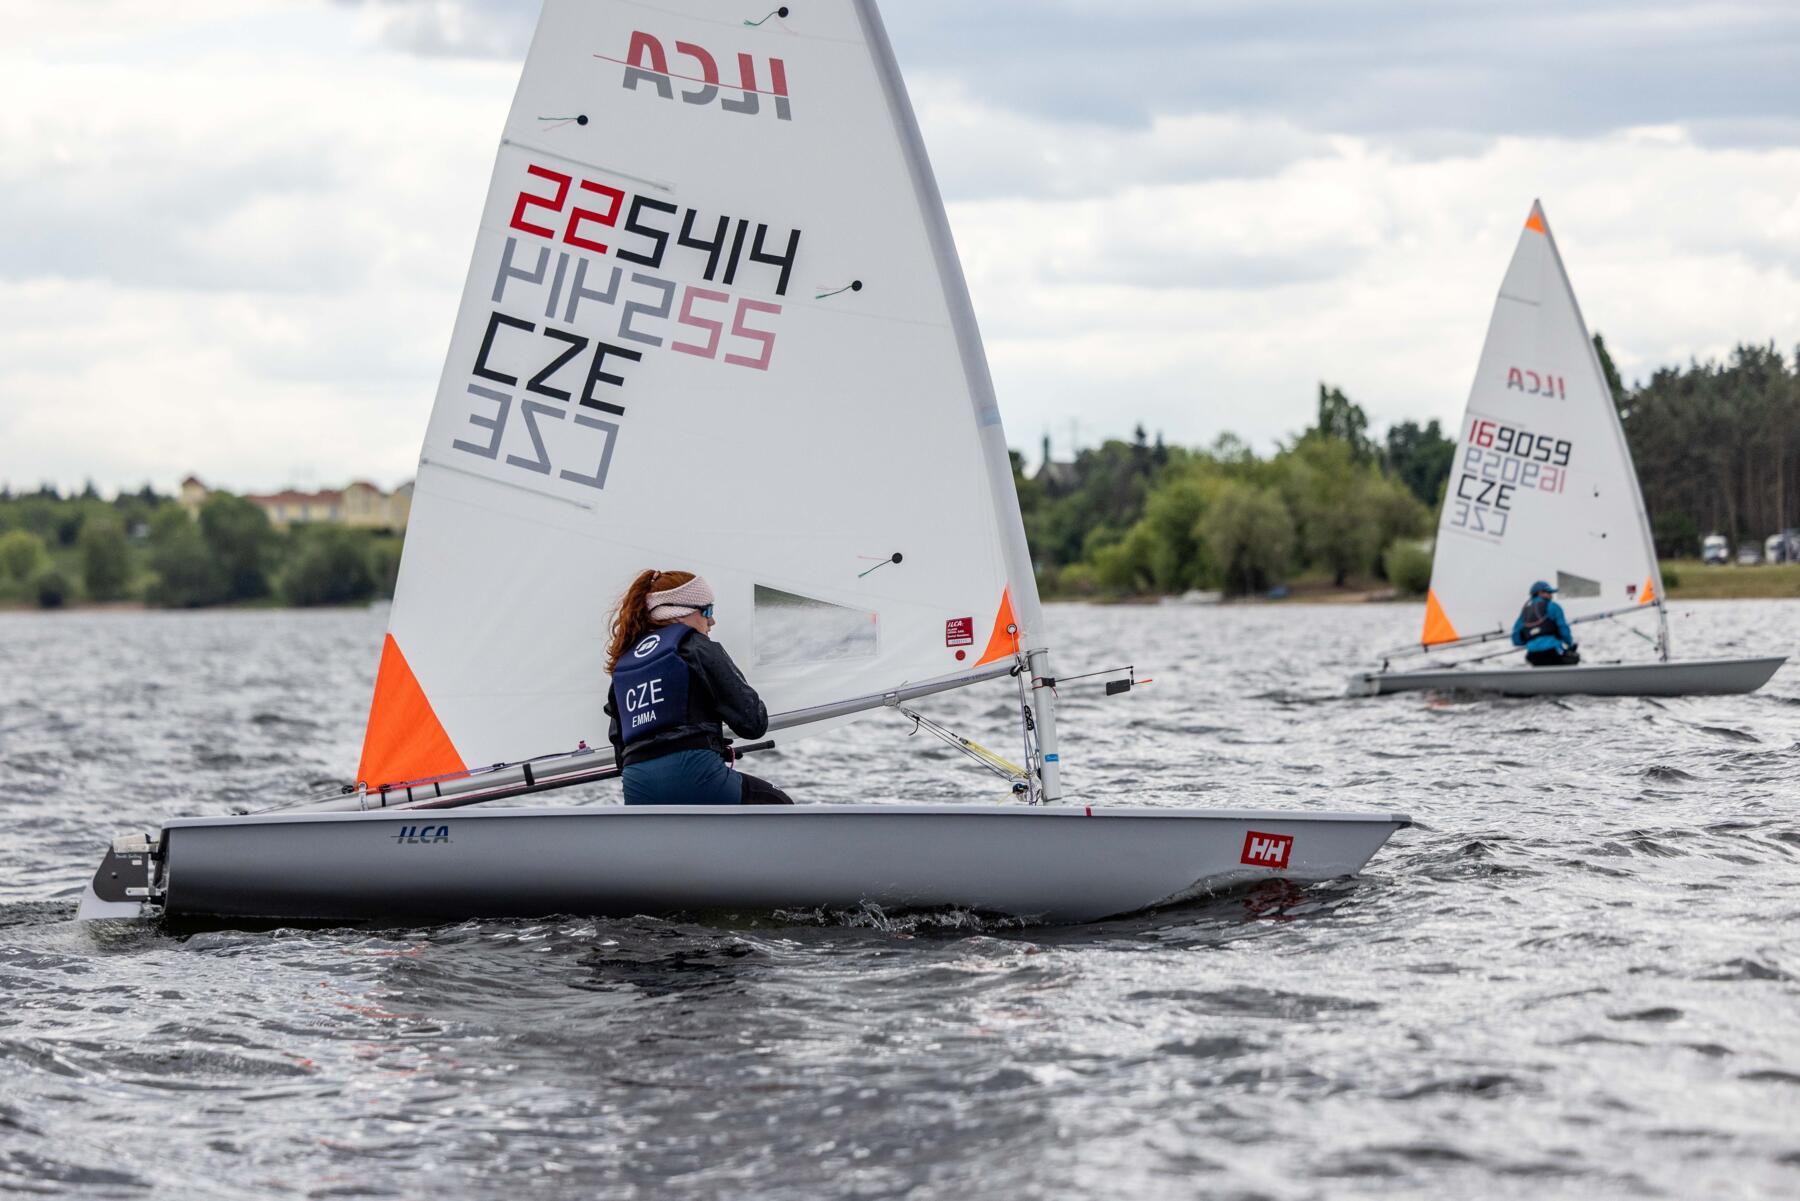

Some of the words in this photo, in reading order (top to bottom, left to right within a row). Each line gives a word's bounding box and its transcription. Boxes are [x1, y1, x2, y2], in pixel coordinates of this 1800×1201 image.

[509, 164, 802, 296] 225414
[472, 310, 643, 417] CZE
[1468, 419, 1573, 467] 169059
[1457, 473, 1516, 511] CZE
[626, 678, 665, 713] CZE
[632, 710, 657, 728] EMMA
[397, 825, 449, 844] ILCA
[1247, 837, 1286, 863] HH
